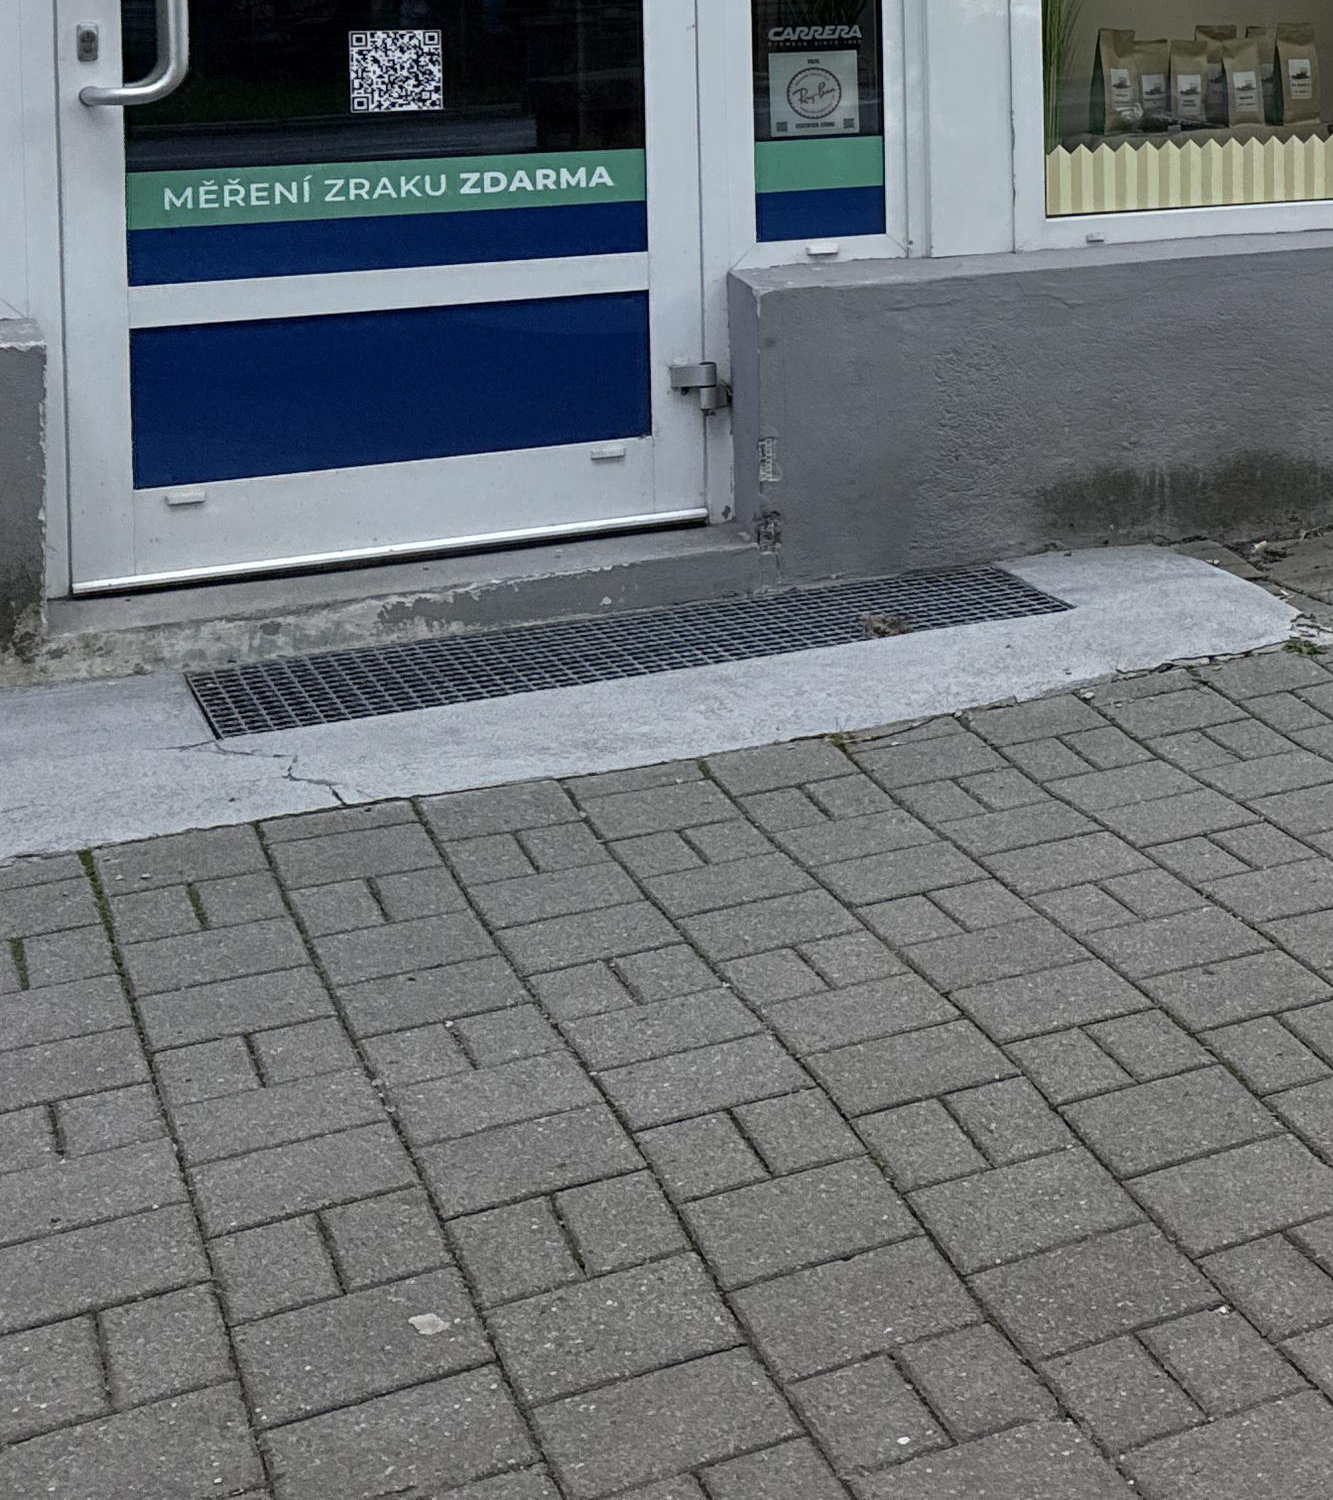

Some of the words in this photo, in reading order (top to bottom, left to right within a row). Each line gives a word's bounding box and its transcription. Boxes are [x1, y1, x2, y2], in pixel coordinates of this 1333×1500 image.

[767, 24, 863, 42] CARRERA
[163, 175, 312, 211] MĚŘENÍ
[323, 173, 447, 202] ZRAKU
[459, 165, 615, 195] ZDARMA
